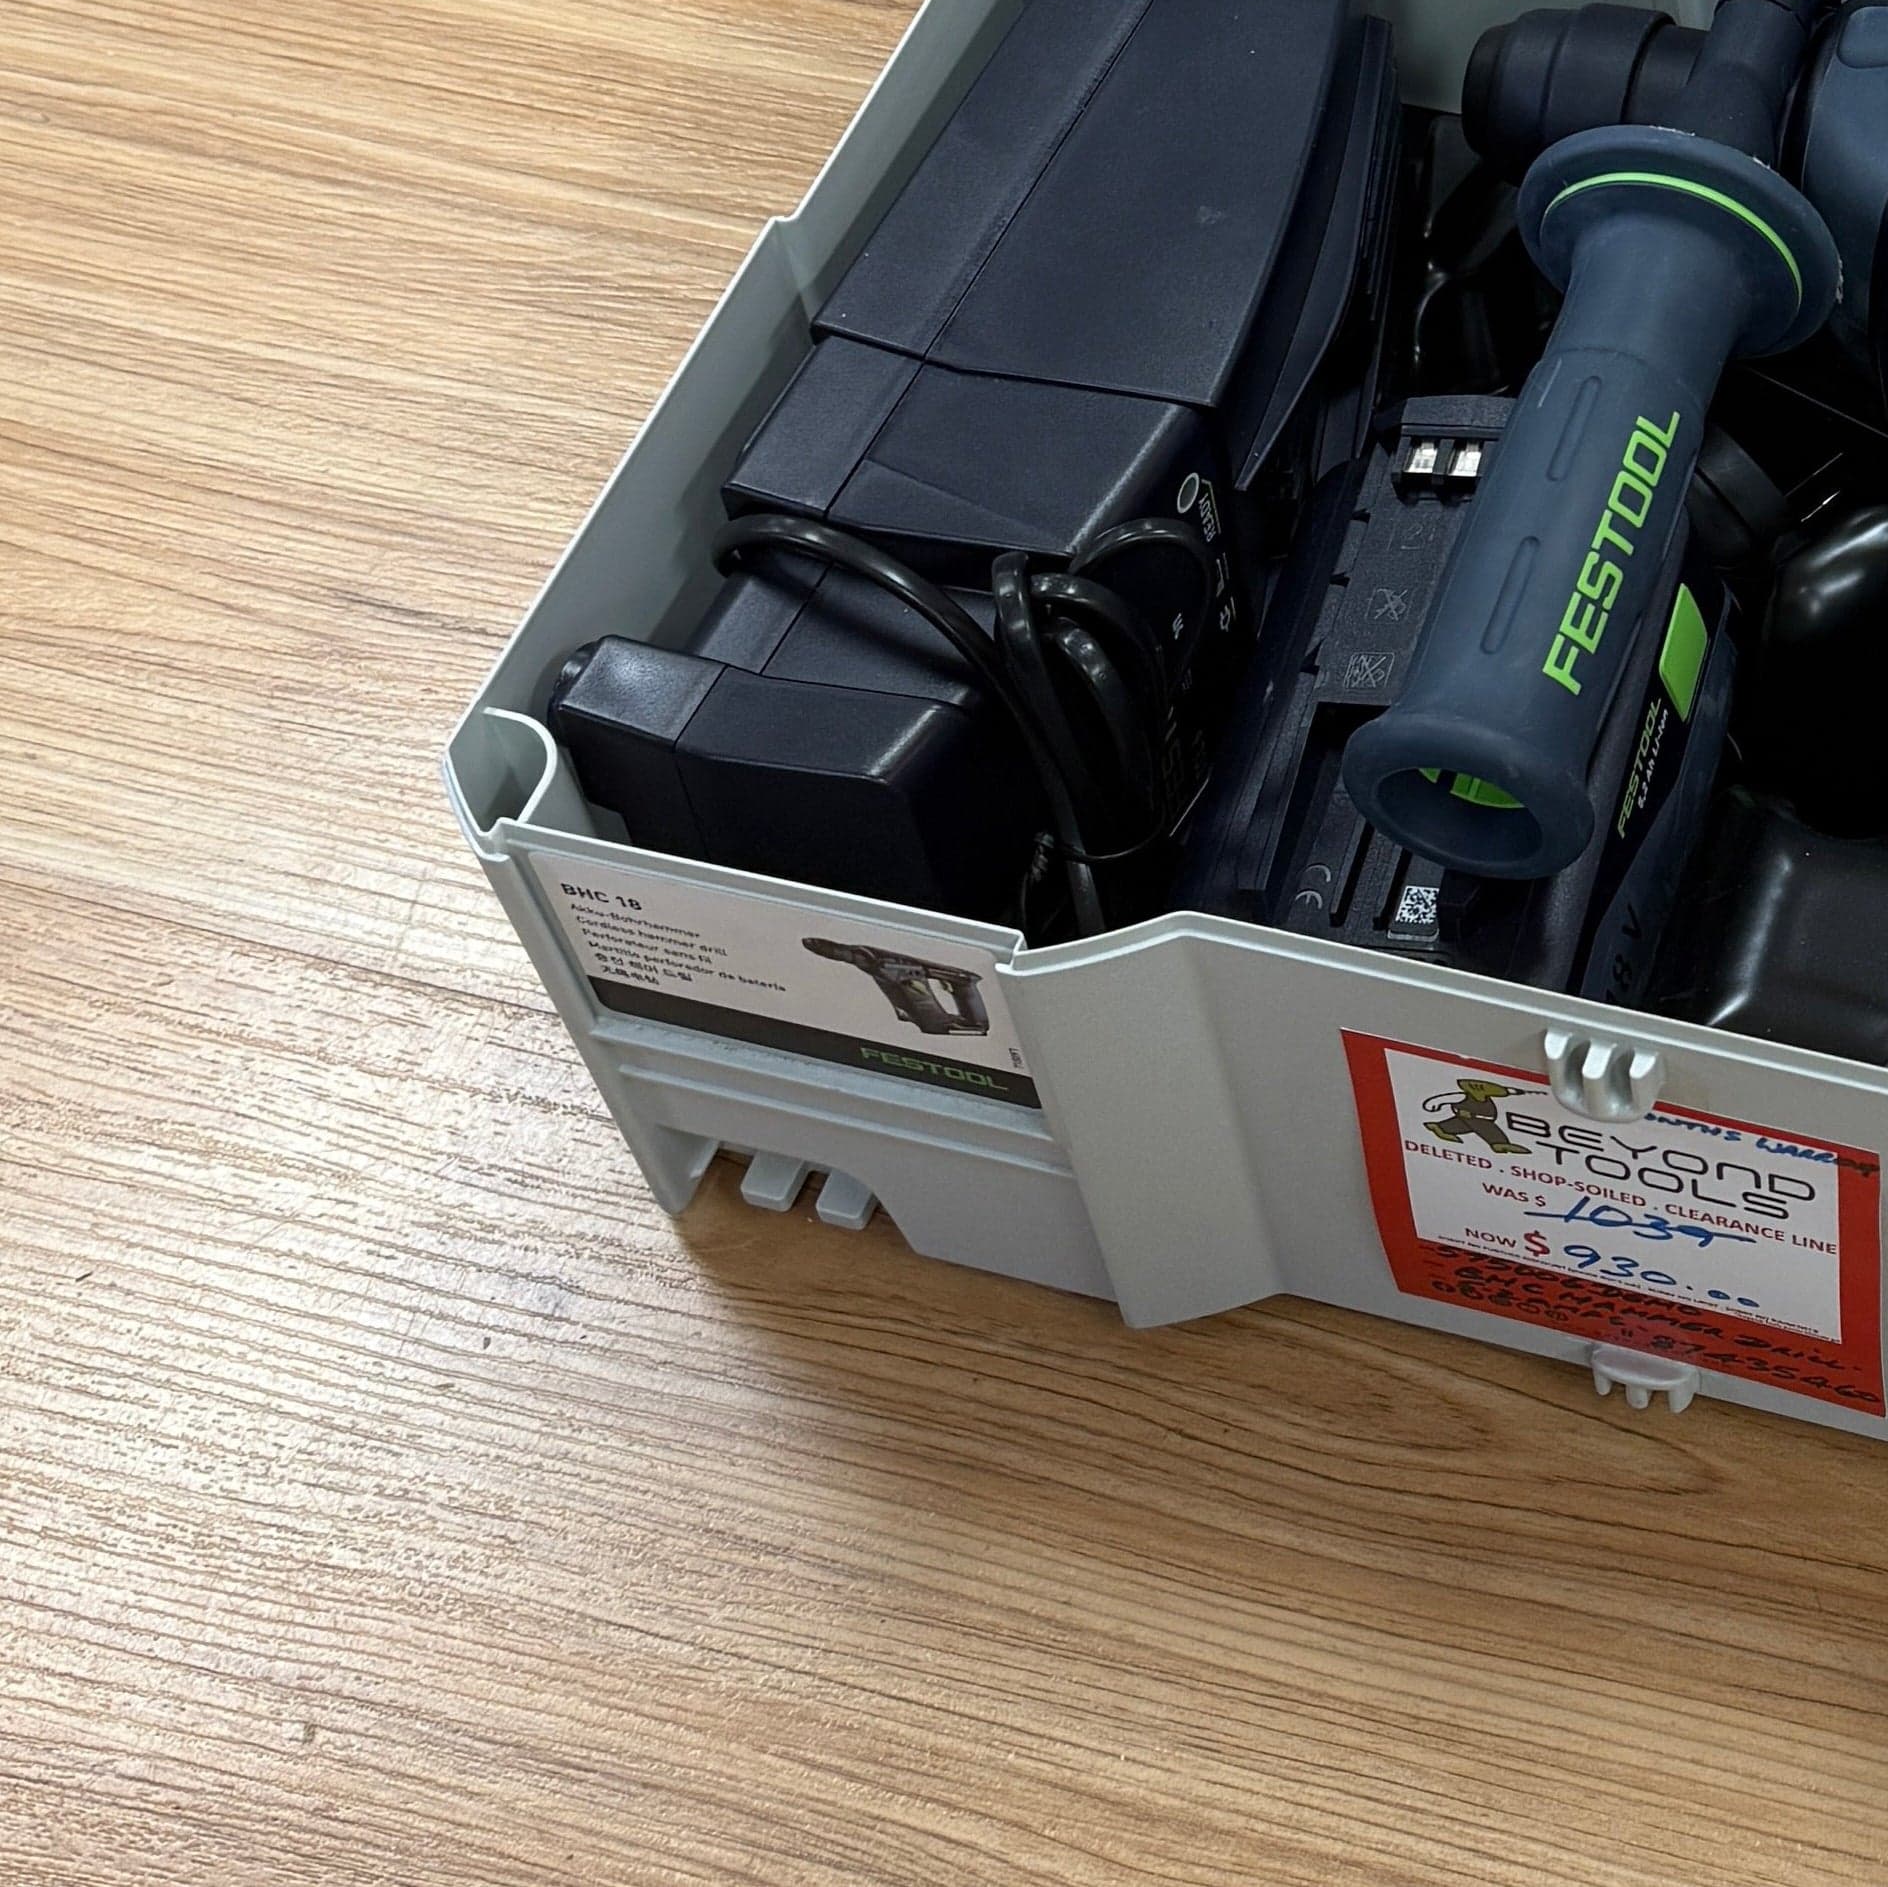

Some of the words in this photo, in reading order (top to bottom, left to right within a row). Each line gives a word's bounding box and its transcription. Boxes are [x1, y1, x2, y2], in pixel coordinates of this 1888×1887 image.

[1542, 409, 1681, 695] FESTOOL
[1616, 696, 1661, 839] FESTOOL
[560, 882, 610, 904] BHC
[615, 896, 643, 911] 18
[637, 930, 696, 950] hammer
[860, 1047, 1010, 1093] FESTOOL
[1506, 1111, 1815, 1203] BEYOND
[1536, 1141, 1789, 1221] TOOLS
[1404, 1139, 1493, 1170] DELETED
[1510, 1165, 1647, 1208] SHOP-SOILED
[1664, 1203, 1786, 1243] CLEARANCE
[1791, 1234, 1838, 1256] LINE
[1482, 1182, 1529, 1203] WAS
[1535, 1194, 1547, 1208] $
[1464, 1227, 1517, 1249] NOW
[1524, 1229, 1552, 1257] $
